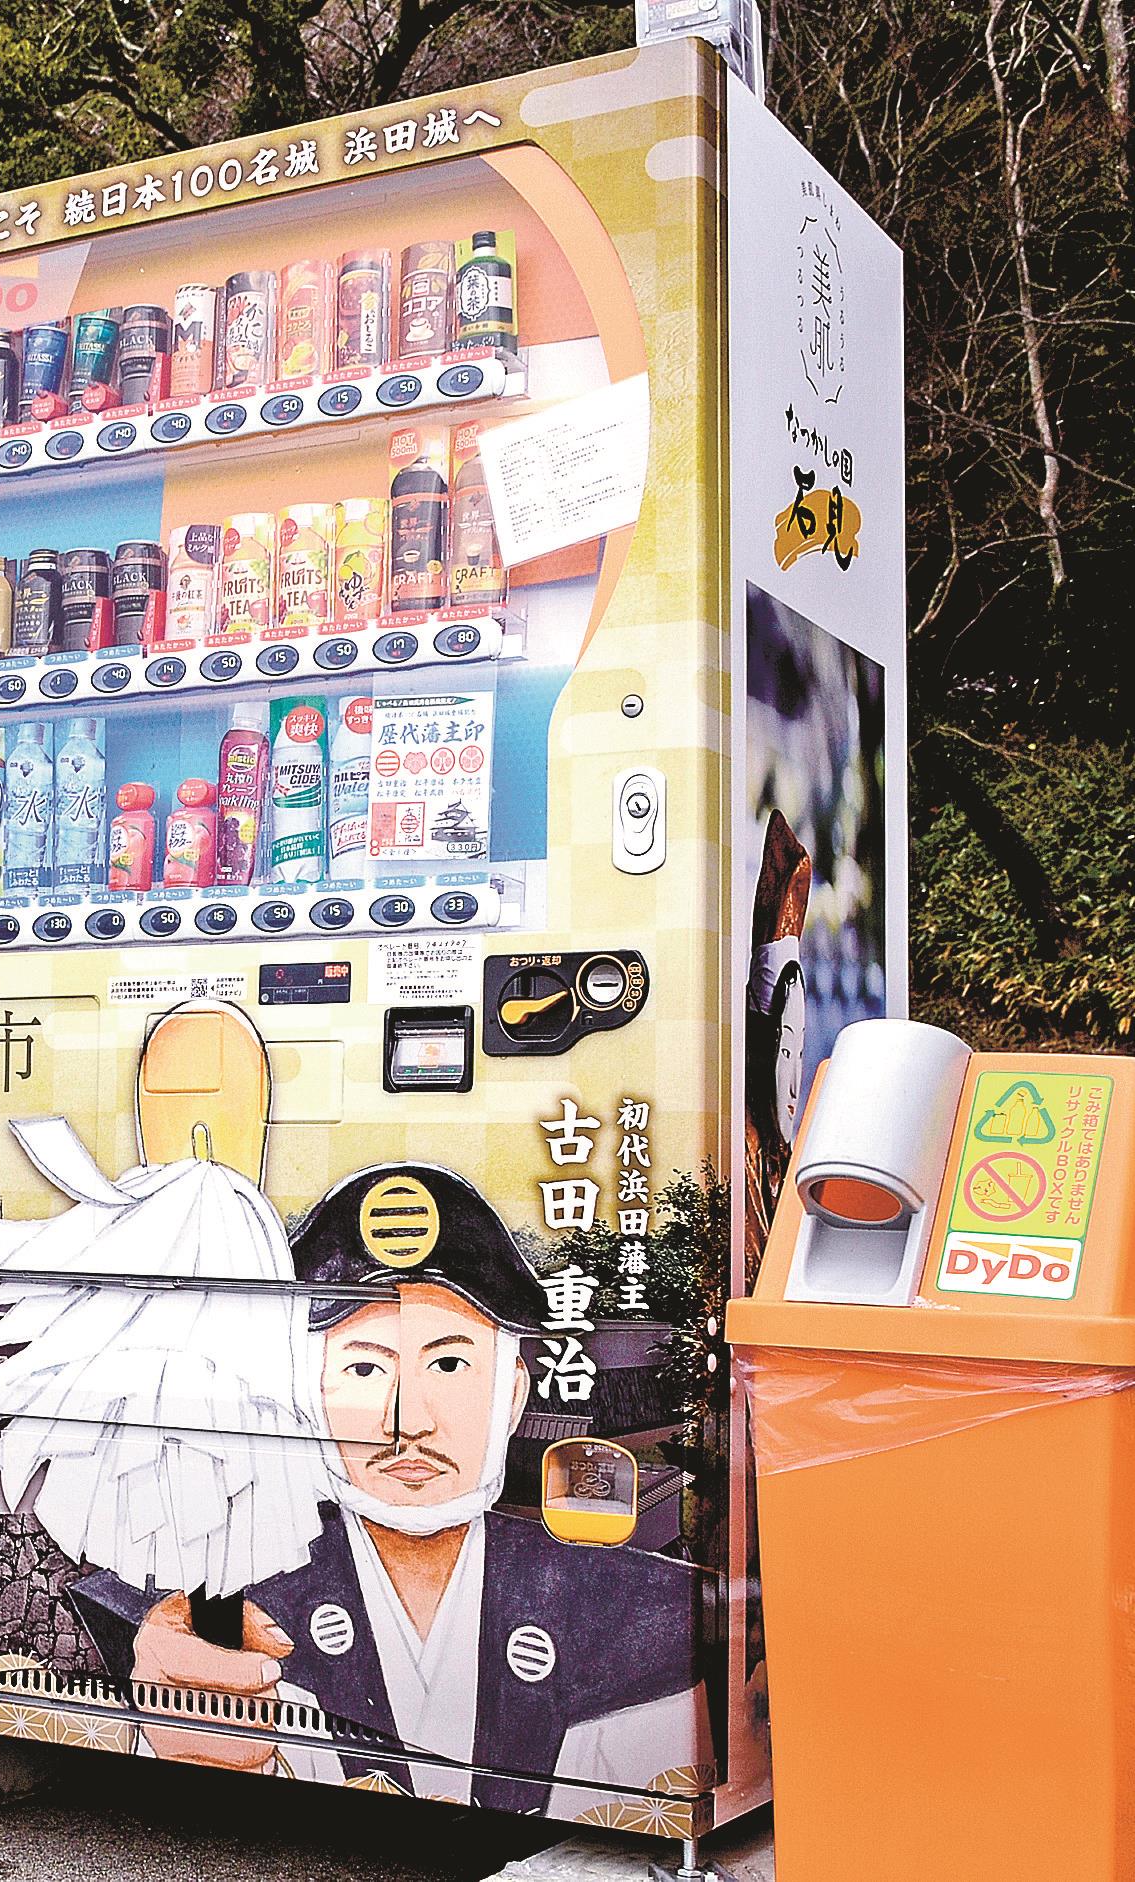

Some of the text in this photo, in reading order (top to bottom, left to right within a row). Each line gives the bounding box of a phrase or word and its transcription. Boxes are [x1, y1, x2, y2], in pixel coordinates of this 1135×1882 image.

[63, 138, 320, 226] 続日本100名城
[342, 106, 502, 168] 浜田城へ
[403, 296, 444, 318] ココア
[393, 434, 413, 447] HOT
[787, 465, 854, 571] 石見
[392, 573, 434, 587] CRAFT
[229, 599, 250, 616] TEA
[286, 590, 308, 608] TEA
[290, 723, 319, 738] 爽快
[377, 719, 485, 746] 歴代藩主印
[12, 790, 46, 826] 水
[63, 785, 99, 822] 水
[448, 898, 464, 910] 33
[509, 955, 562, 967] おつり・返却
[538, 1098, 602, 1233] 古田
[1045, 1085, 1083, 1224] リサイクルBOXです
[1064, 1086, 1104, 1226] ごみ箱ではありません
[617, 1097, 652, 1311] 初代浜田藩主
[945, 1249, 1070, 1285] DyDo
[535, 1263, 601, 1403] 重治
